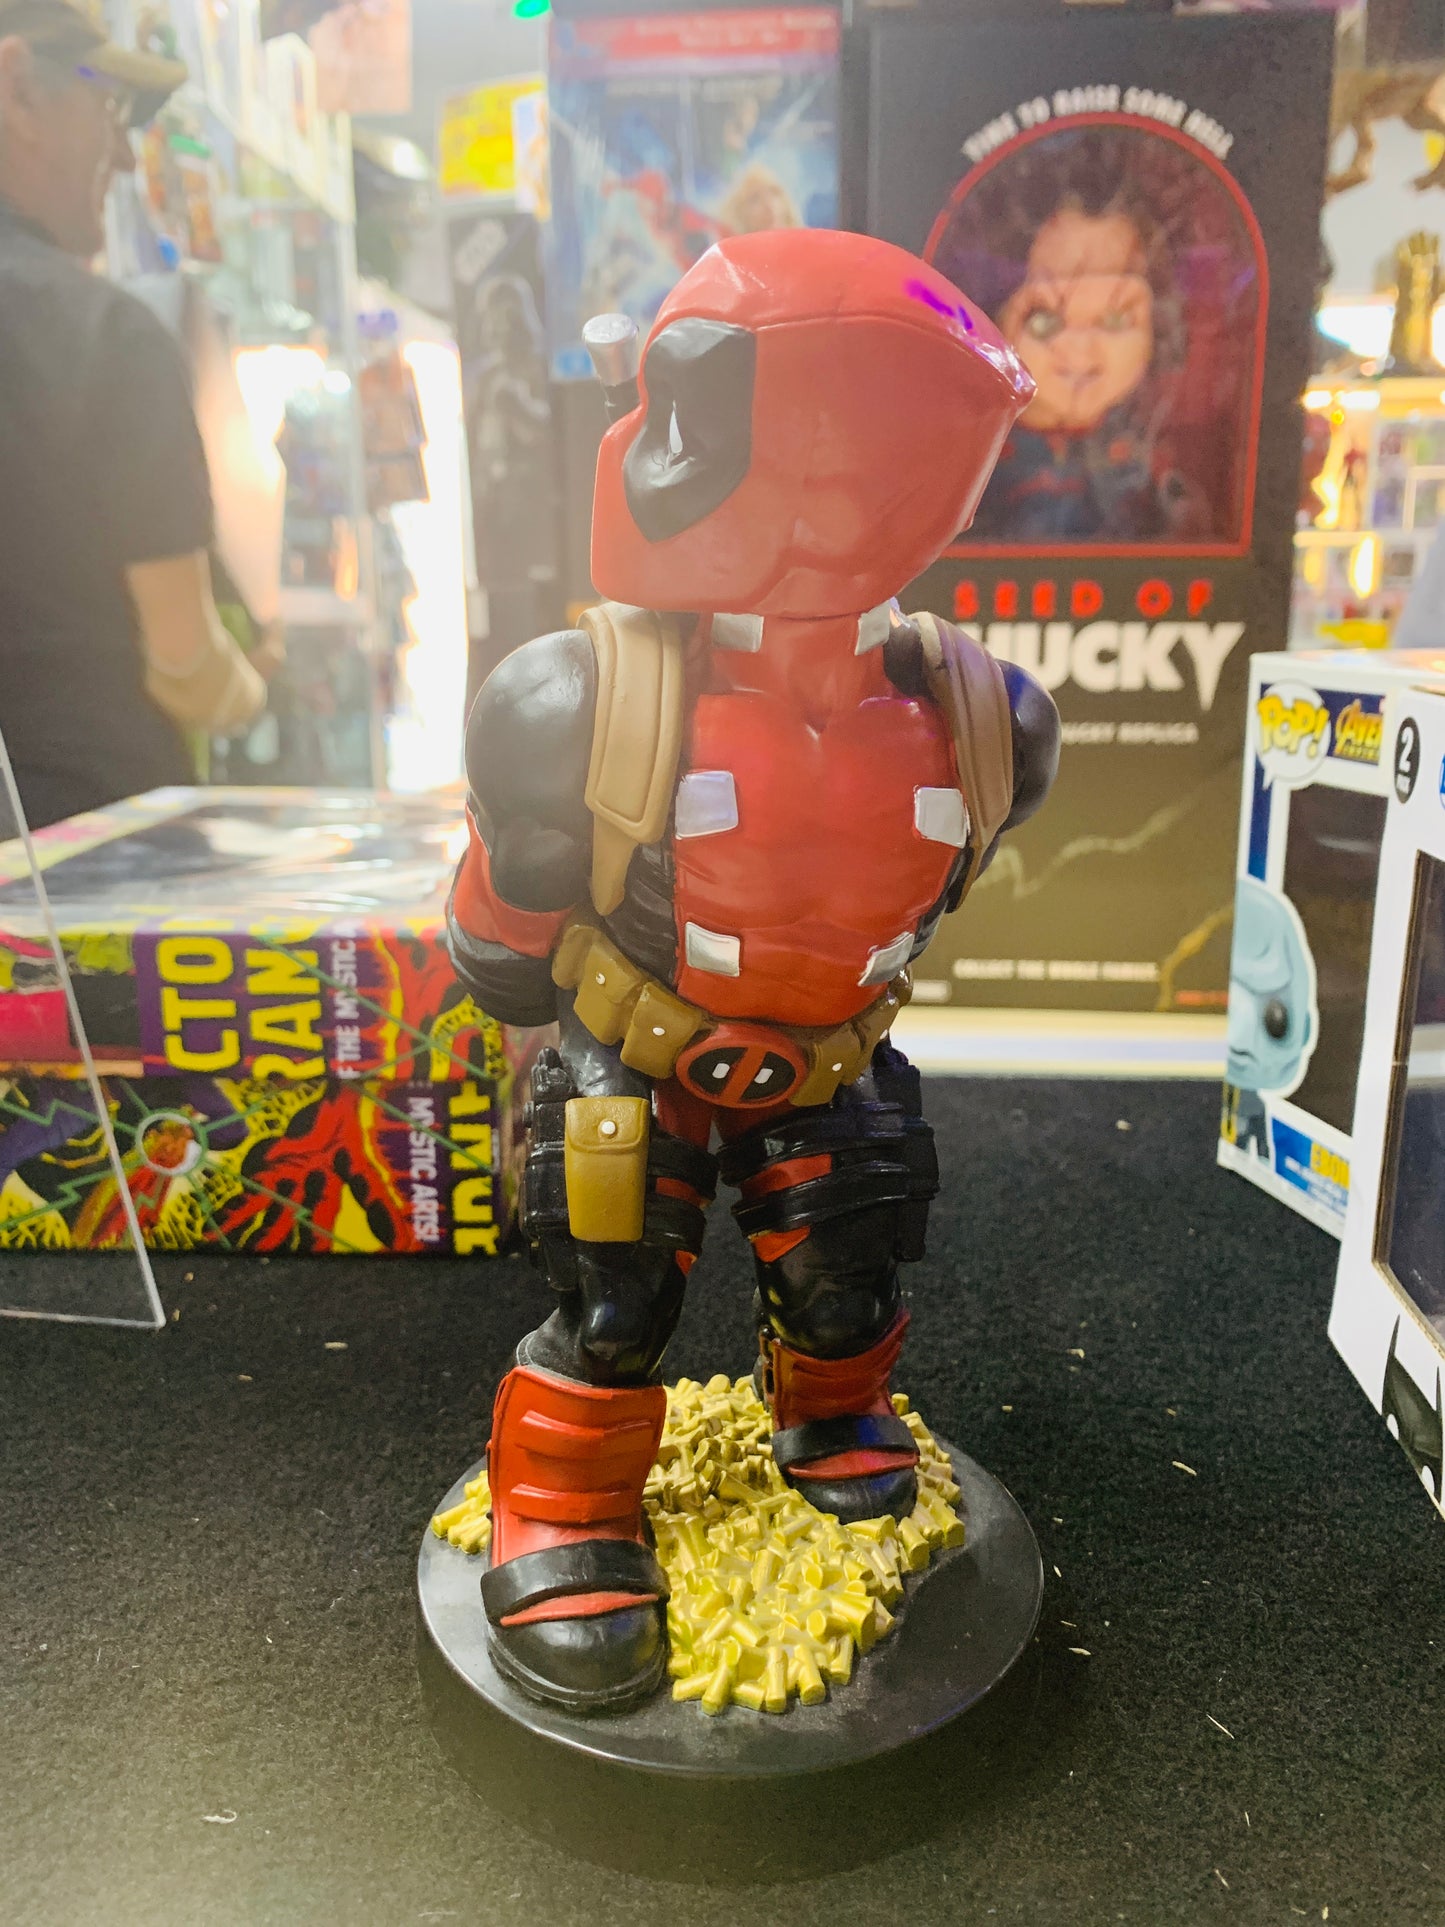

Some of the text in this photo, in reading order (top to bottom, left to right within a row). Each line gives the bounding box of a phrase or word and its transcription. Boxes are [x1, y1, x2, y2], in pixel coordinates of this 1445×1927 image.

[953, 577, 1214, 620] SEED OF
[1257, 693, 1330, 760] POP!
[1399, 726, 1414, 773] 2
[334, 1025, 362, 1061] THE
